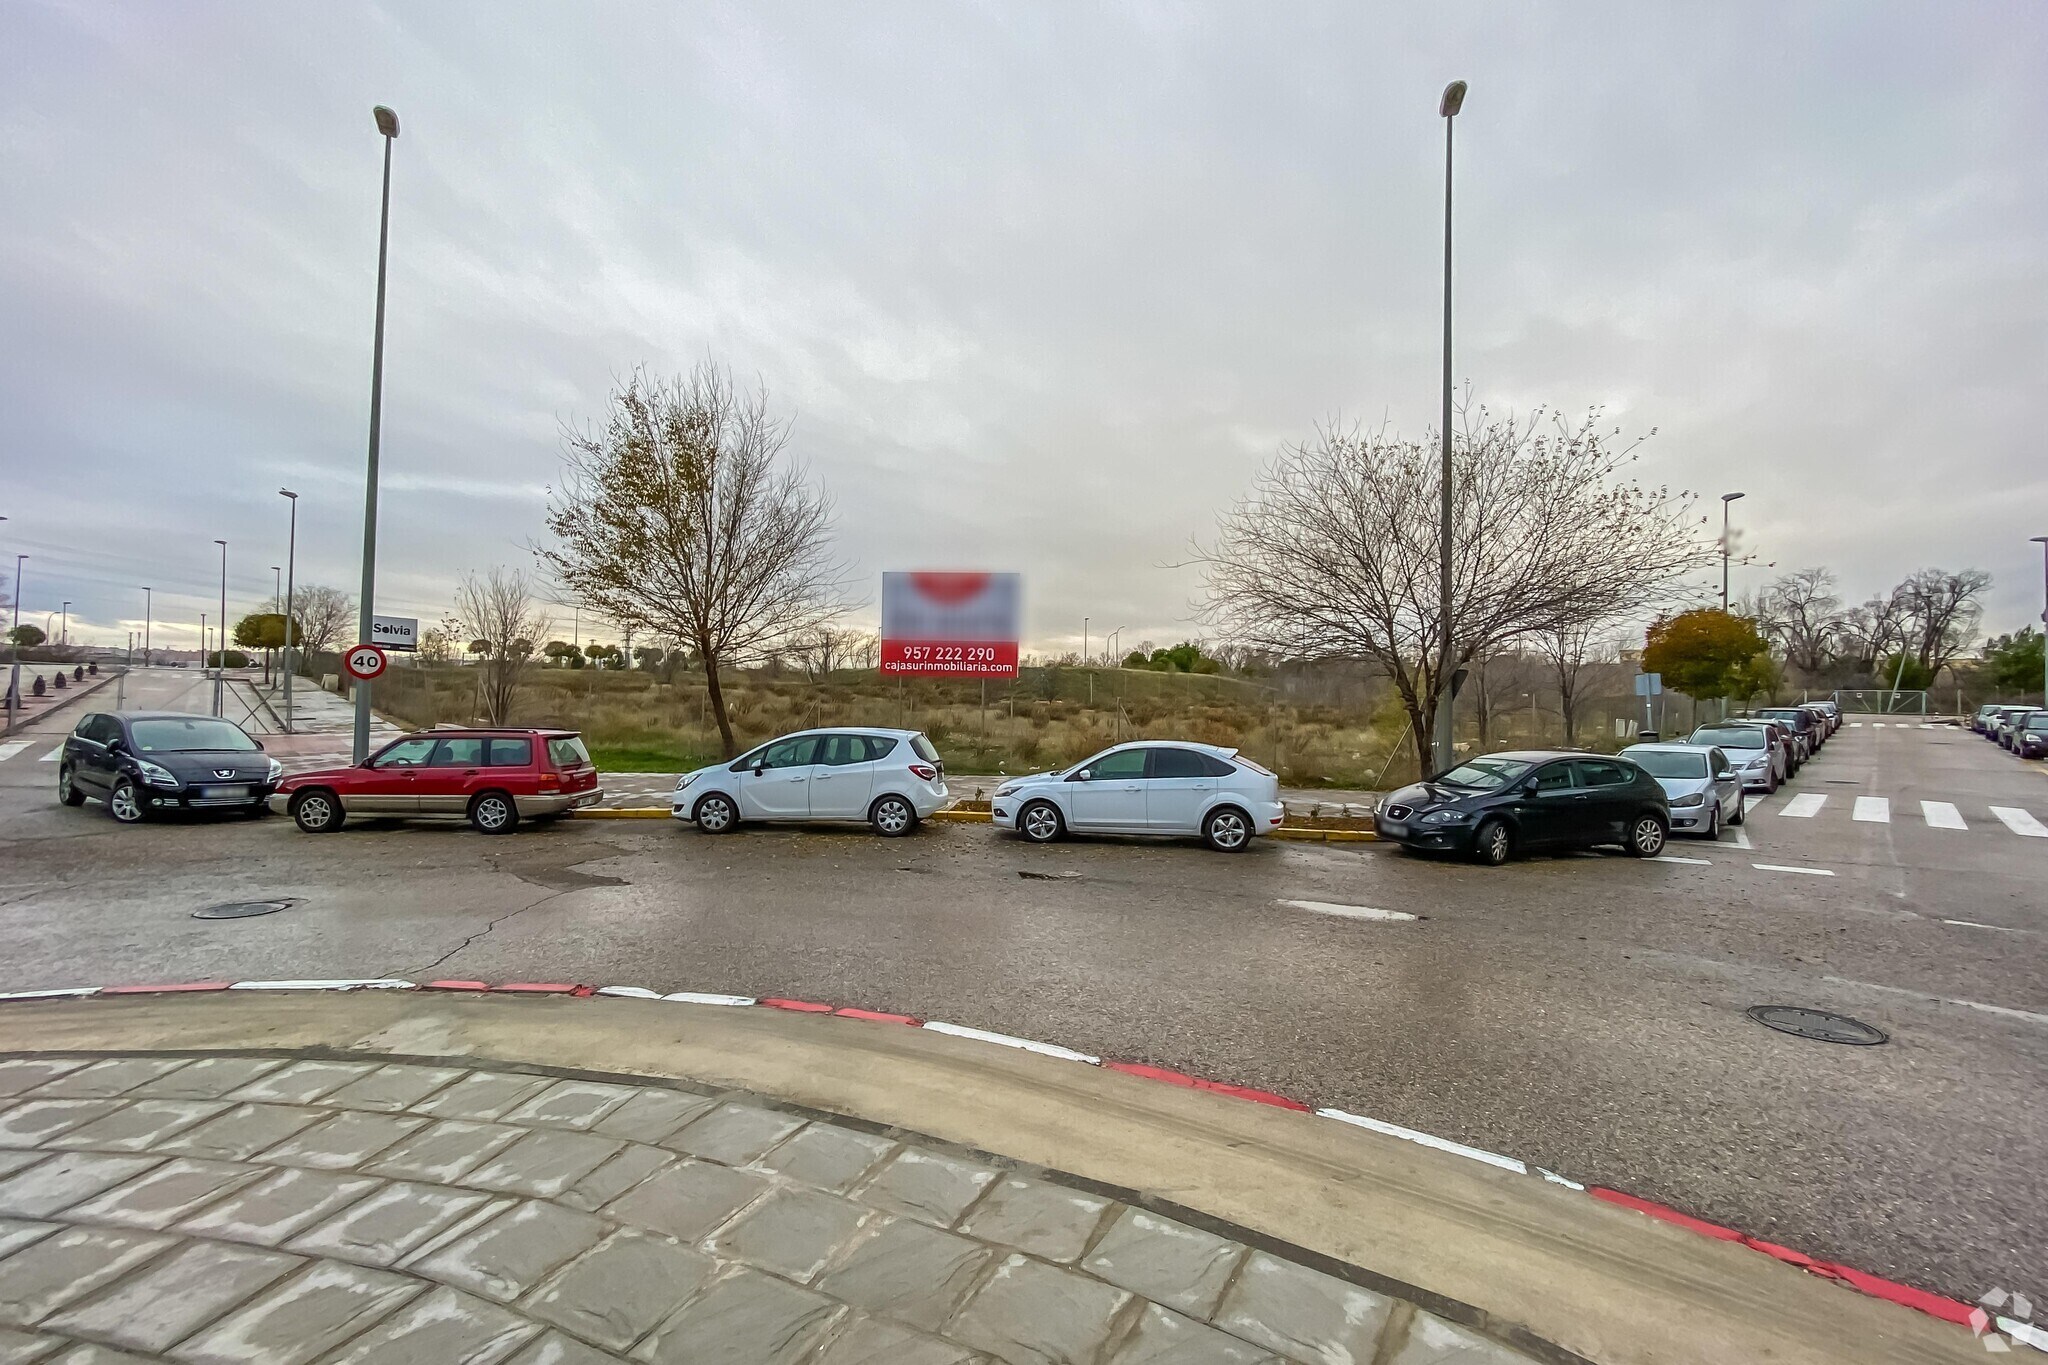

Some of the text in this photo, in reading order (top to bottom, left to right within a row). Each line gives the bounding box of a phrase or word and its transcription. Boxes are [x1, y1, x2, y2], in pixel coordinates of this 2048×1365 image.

[373, 623, 411, 636] Solvia
[903, 646, 995, 661] 957 222 290
[353, 655, 378, 668] 40
[885, 660, 1013, 672] cajasurinmobiliaria.com
